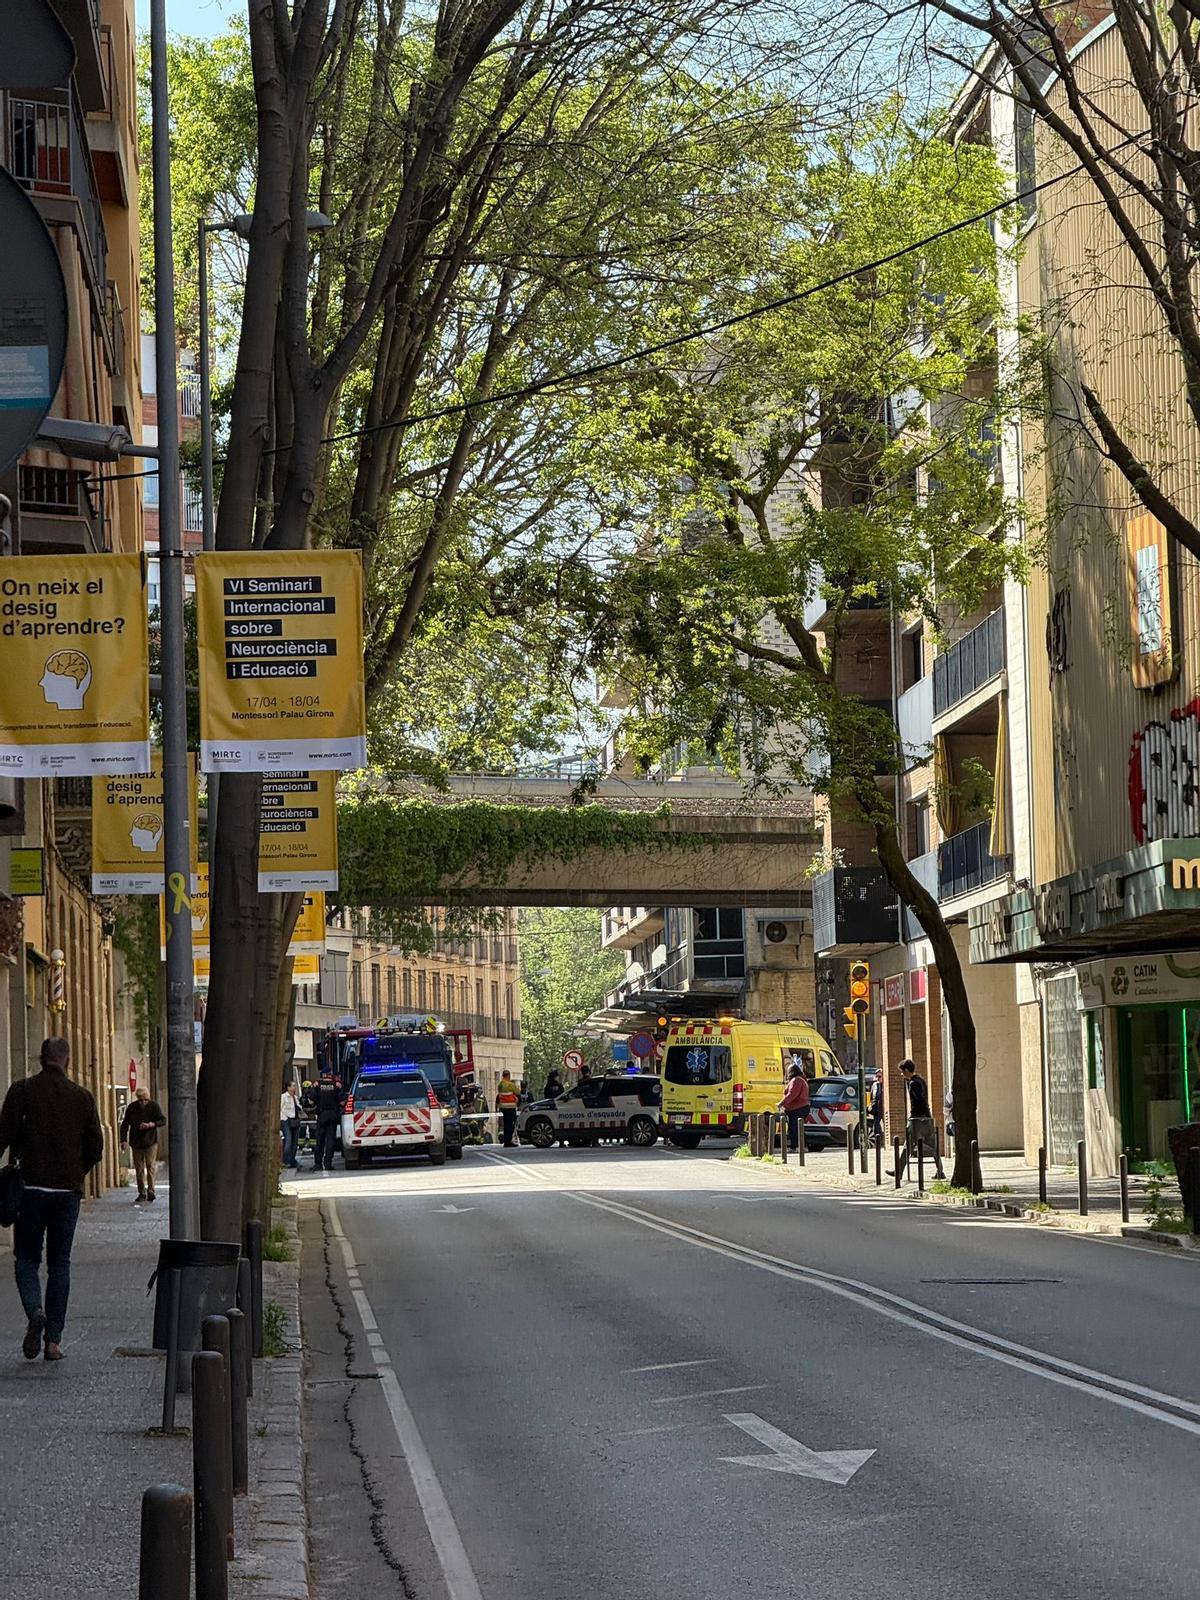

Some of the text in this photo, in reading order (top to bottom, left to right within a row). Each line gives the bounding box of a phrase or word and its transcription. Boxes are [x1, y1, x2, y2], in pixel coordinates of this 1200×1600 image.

[2, 578, 103, 597] On neix el
[230, 579, 313, 593] VI Seminari
[2, 600, 58, 619] desig
[230, 599, 325, 613] Internacional
[2, 618, 126, 640] d'aprendre?
[230, 621, 273, 636] sobre
[231, 641, 328, 656] Neurociència
[232, 662, 309, 677] i Educació
[246, 697, 278, 708] 17/04
[289, 696, 321, 707] 18/04
[232, 709, 335, 720] Montessori Palau Girona
[0, 755, 23, 763] IRTC
[91, 755, 136, 763] www.mirtc.com
[212, 751, 241, 759] MIRTC
[308, 751, 352, 759] www.mirtc.com
[106, 781, 142, 795] desig
[262, 782, 312, 792] ernacional
[106, 794, 164, 807] d'aprend
[261, 796, 279, 805] bre
[260, 809, 313, 819] eurociència
[1134, 965, 1158, 977] CATIM
[675, 1034, 723, 1045] AMBULÀNCIA
